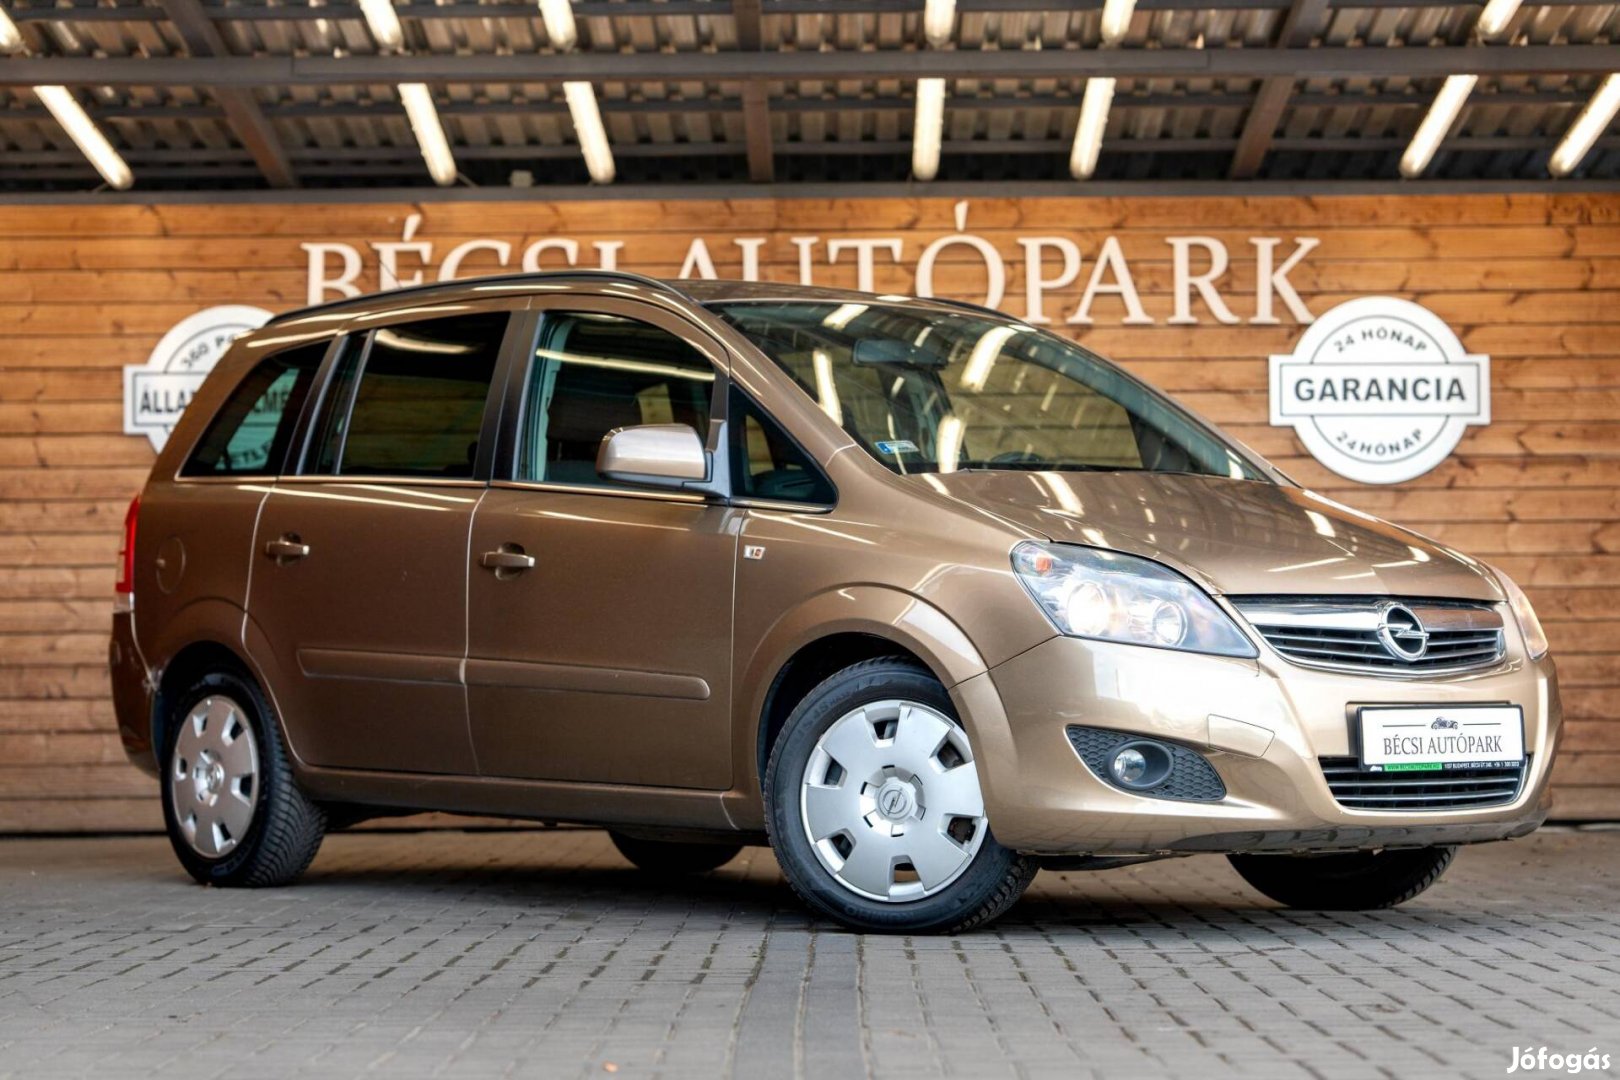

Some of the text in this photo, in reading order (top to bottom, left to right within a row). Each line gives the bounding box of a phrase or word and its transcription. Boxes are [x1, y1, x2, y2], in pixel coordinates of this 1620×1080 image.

[1294, 377, 1467, 402] GARANCIA
[1383, 732, 1503, 756] BÉCSI AUTÓPARK
